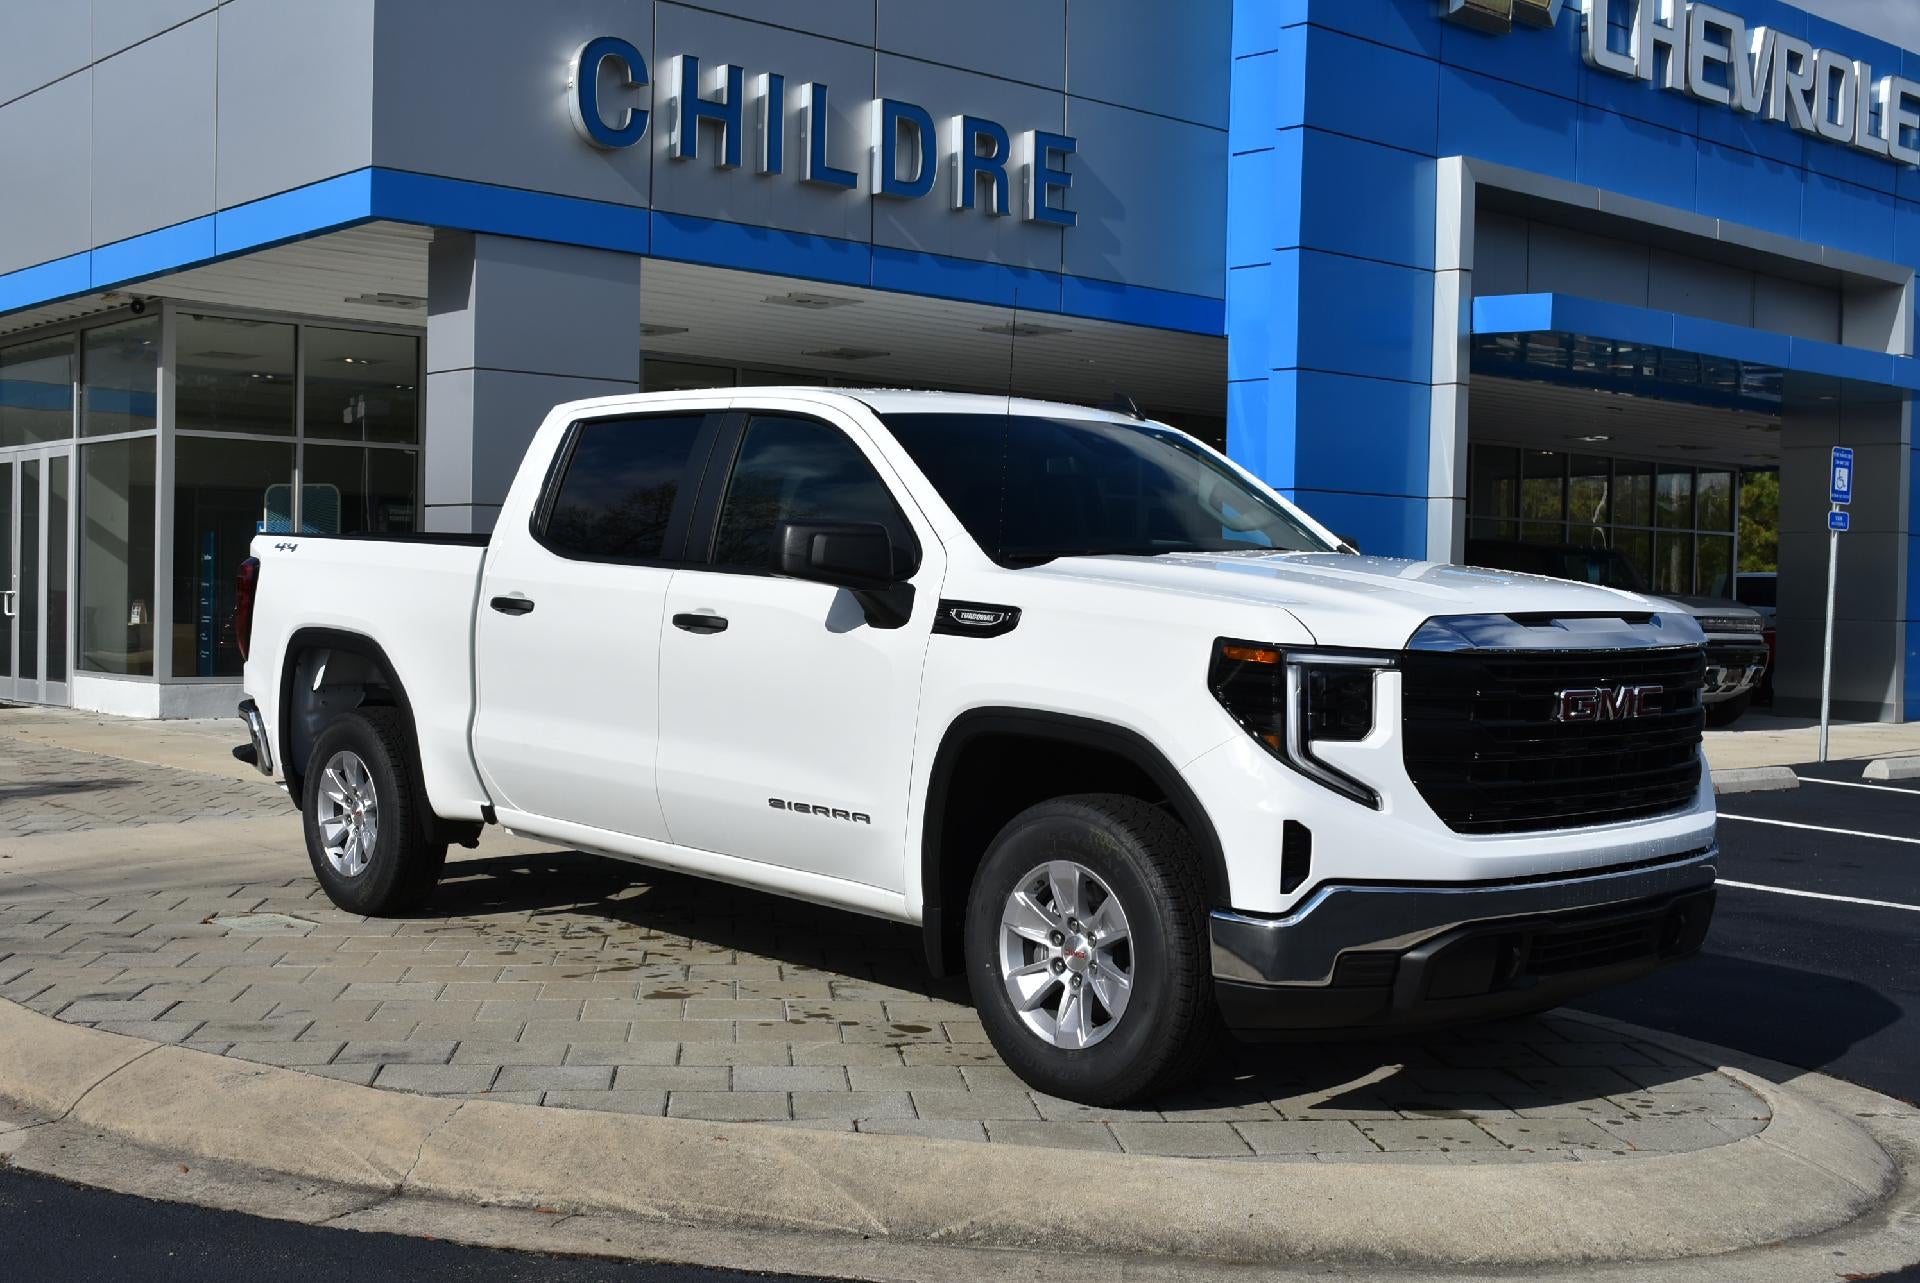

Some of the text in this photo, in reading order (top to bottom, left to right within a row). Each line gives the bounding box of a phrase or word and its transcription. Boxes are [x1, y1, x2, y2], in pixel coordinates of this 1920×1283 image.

[570, 36, 1078, 226] CHILDRE
[1558, 684, 1664, 722] GMC
[768, 798, 871, 825] SIERRA
